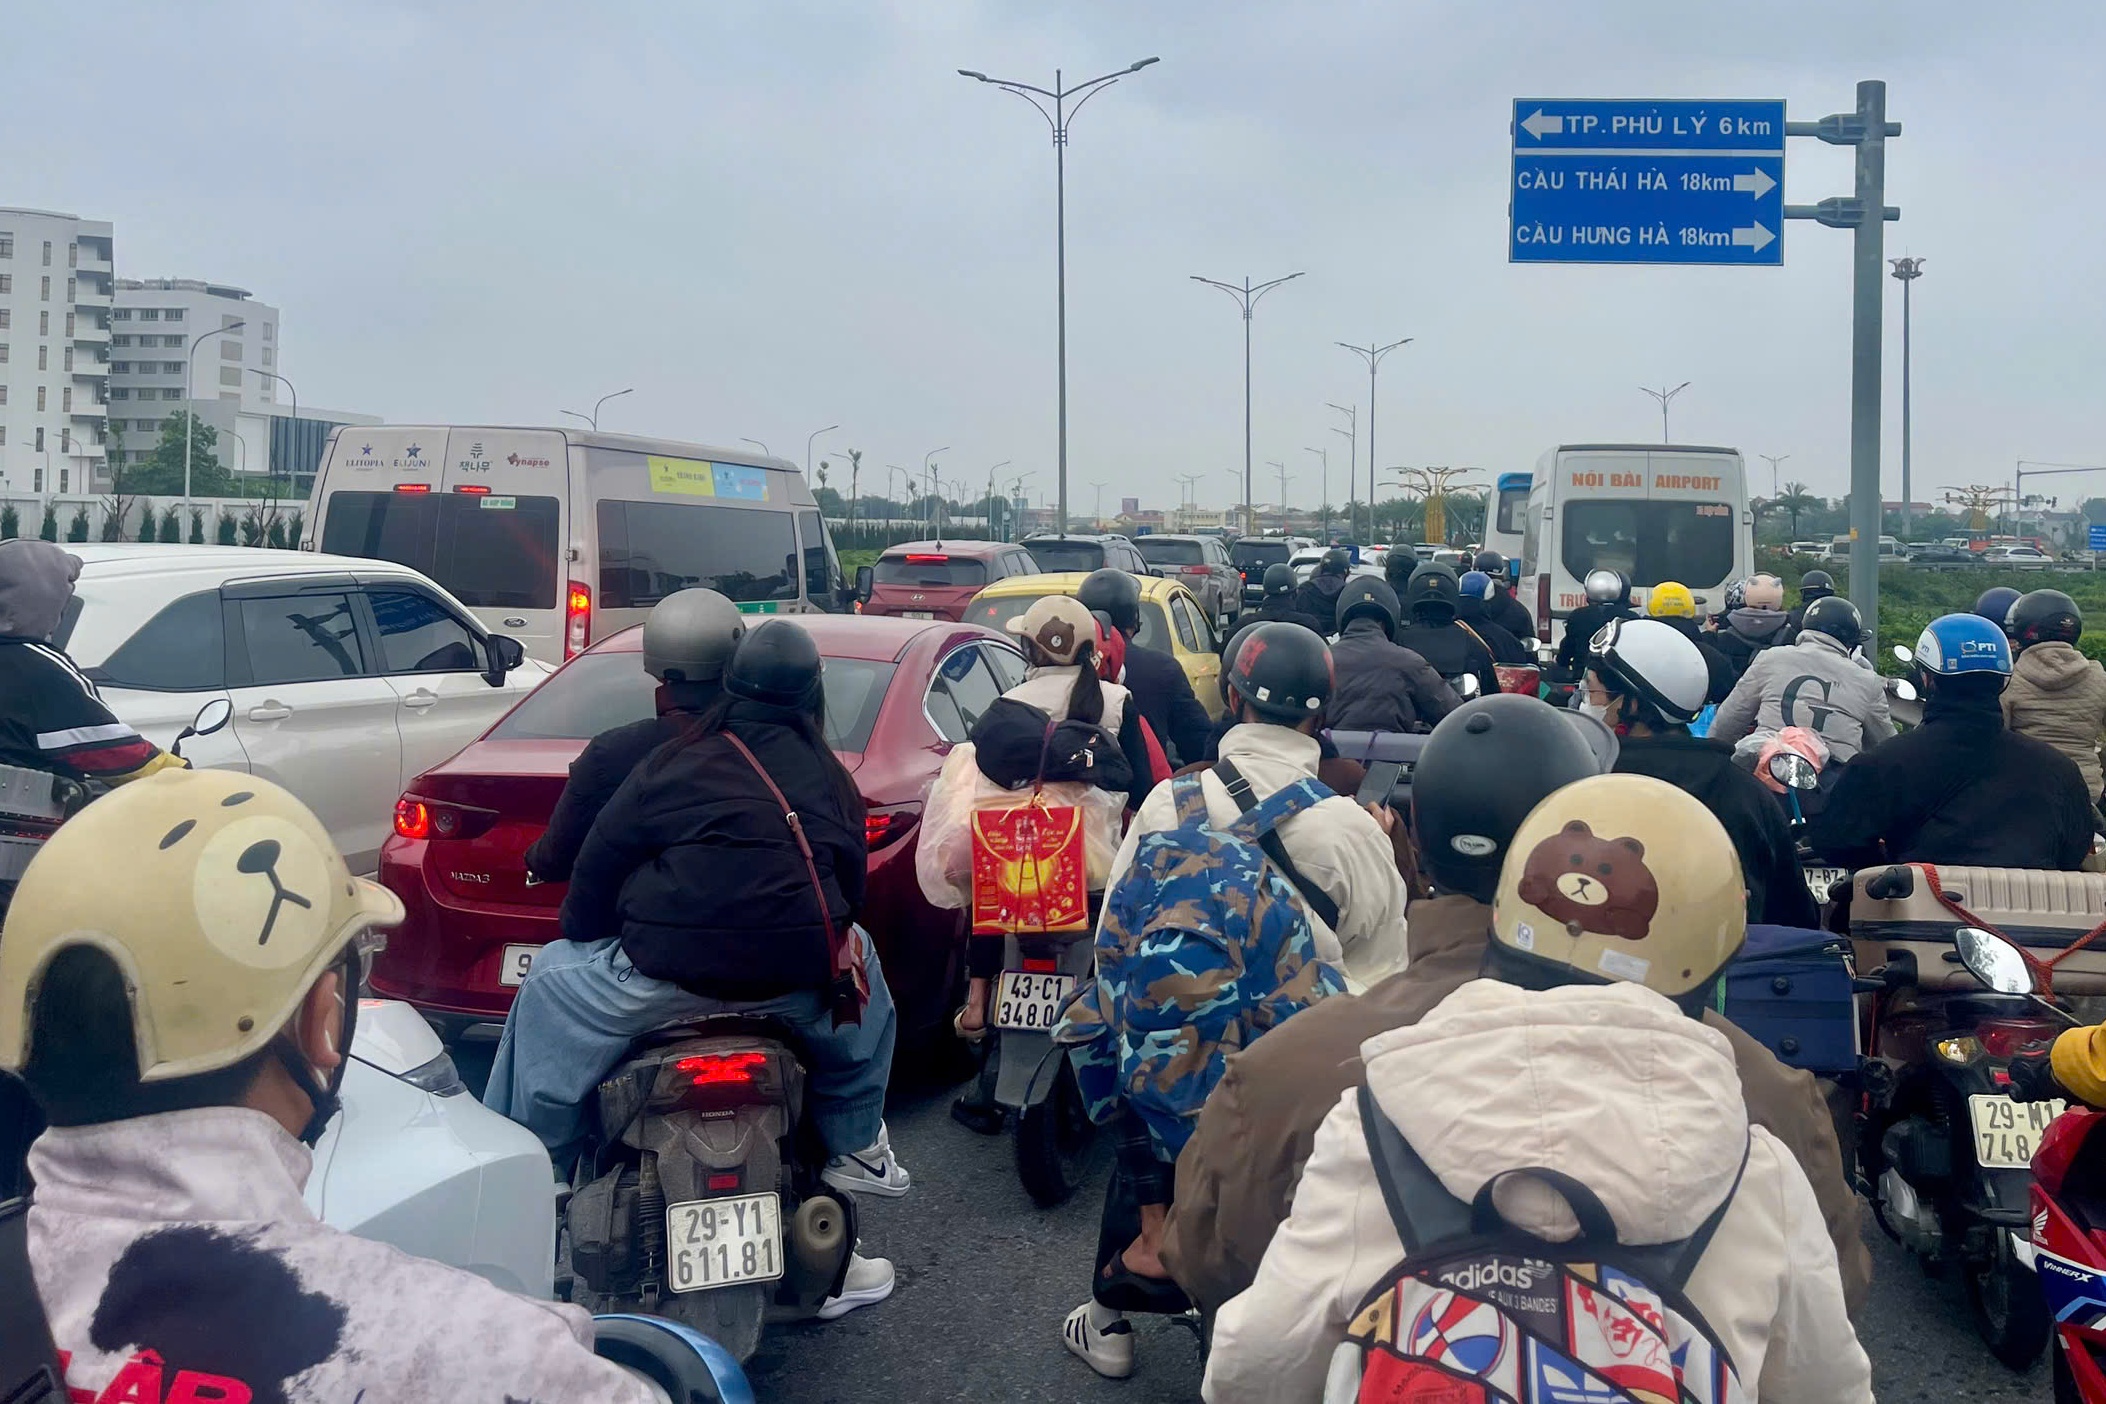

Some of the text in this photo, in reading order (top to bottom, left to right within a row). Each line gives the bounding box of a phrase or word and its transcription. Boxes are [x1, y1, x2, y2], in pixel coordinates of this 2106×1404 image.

[1673, 110, 1707, 135] LÝ
[1576, 167, 1627, 190] THÁI
[1637, 167, 1668, 190] HÀ
[1680, 173, 1731, 191] 18km
[1572, 226, 1631, 244] HƯNG
[1639, 221, 1670, 245] HÀ
[1679, 227, 1730, 246] 18km
[1571, 470, 1721, 491] NỘI BÀI AIRPORT
[1978, 642, 1997, 652] PTI
[1780, 674, 1834, 733] G
[1000, 1001, 1055, 1028] 348.0
[701, 1109, 735, 1118] HONDA
[685, 1200, 762, 1244] 29-Y1
[677, 1238, 774, 1285] 611.81
[1440, 1258, 1534, 1290] adidas
